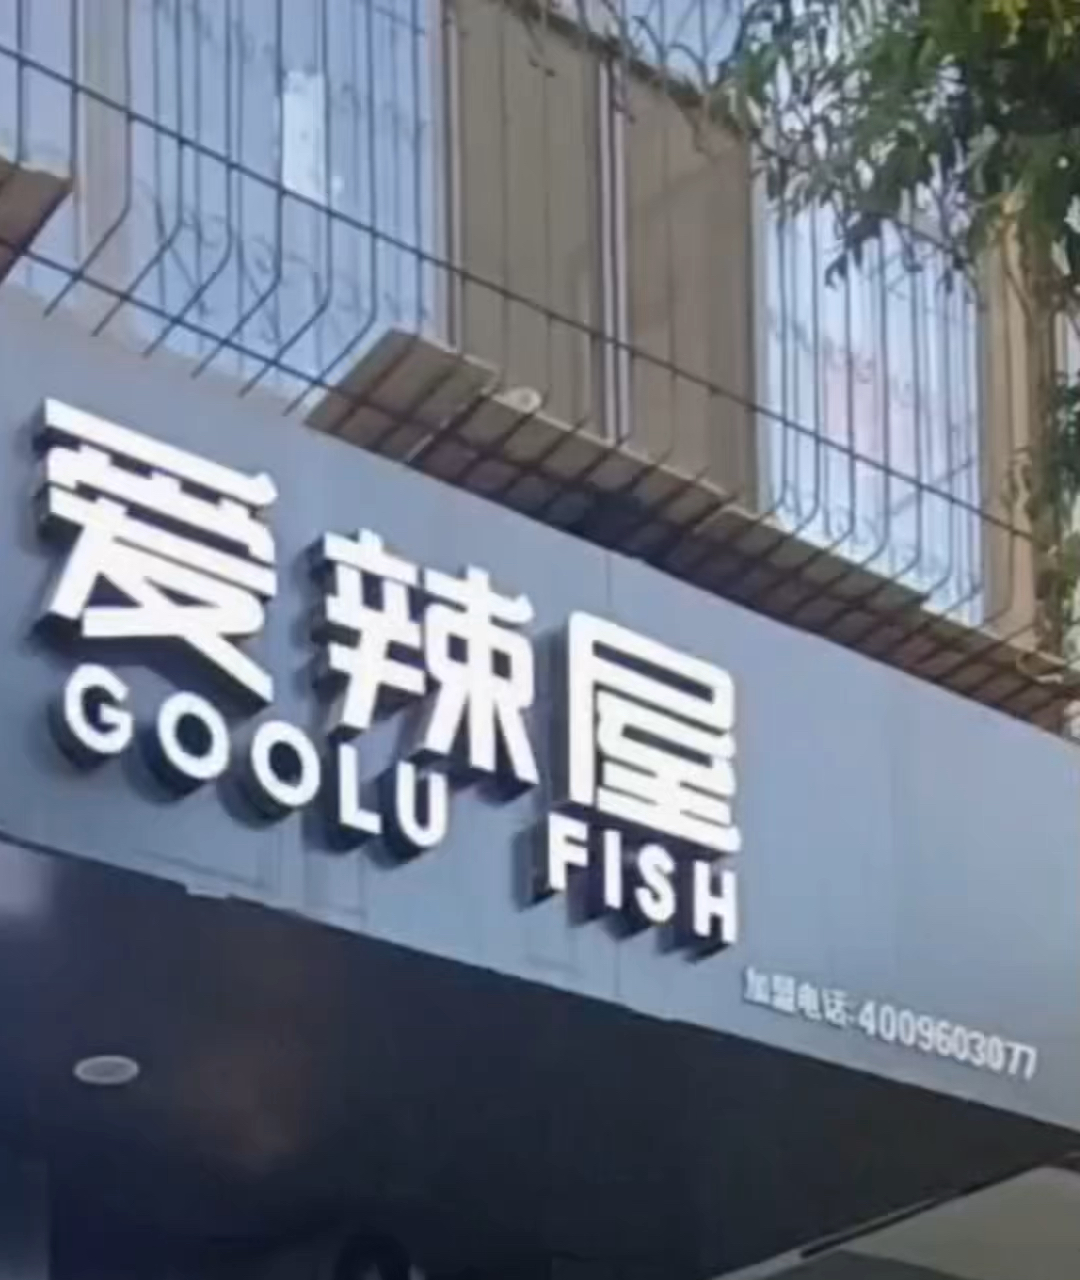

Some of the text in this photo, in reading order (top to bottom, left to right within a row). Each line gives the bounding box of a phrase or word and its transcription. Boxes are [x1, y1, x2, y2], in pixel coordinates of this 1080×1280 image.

[42, 398, 742, 854] 爱辣屋
[64, 663, 740, 944] GOOLU FISH
